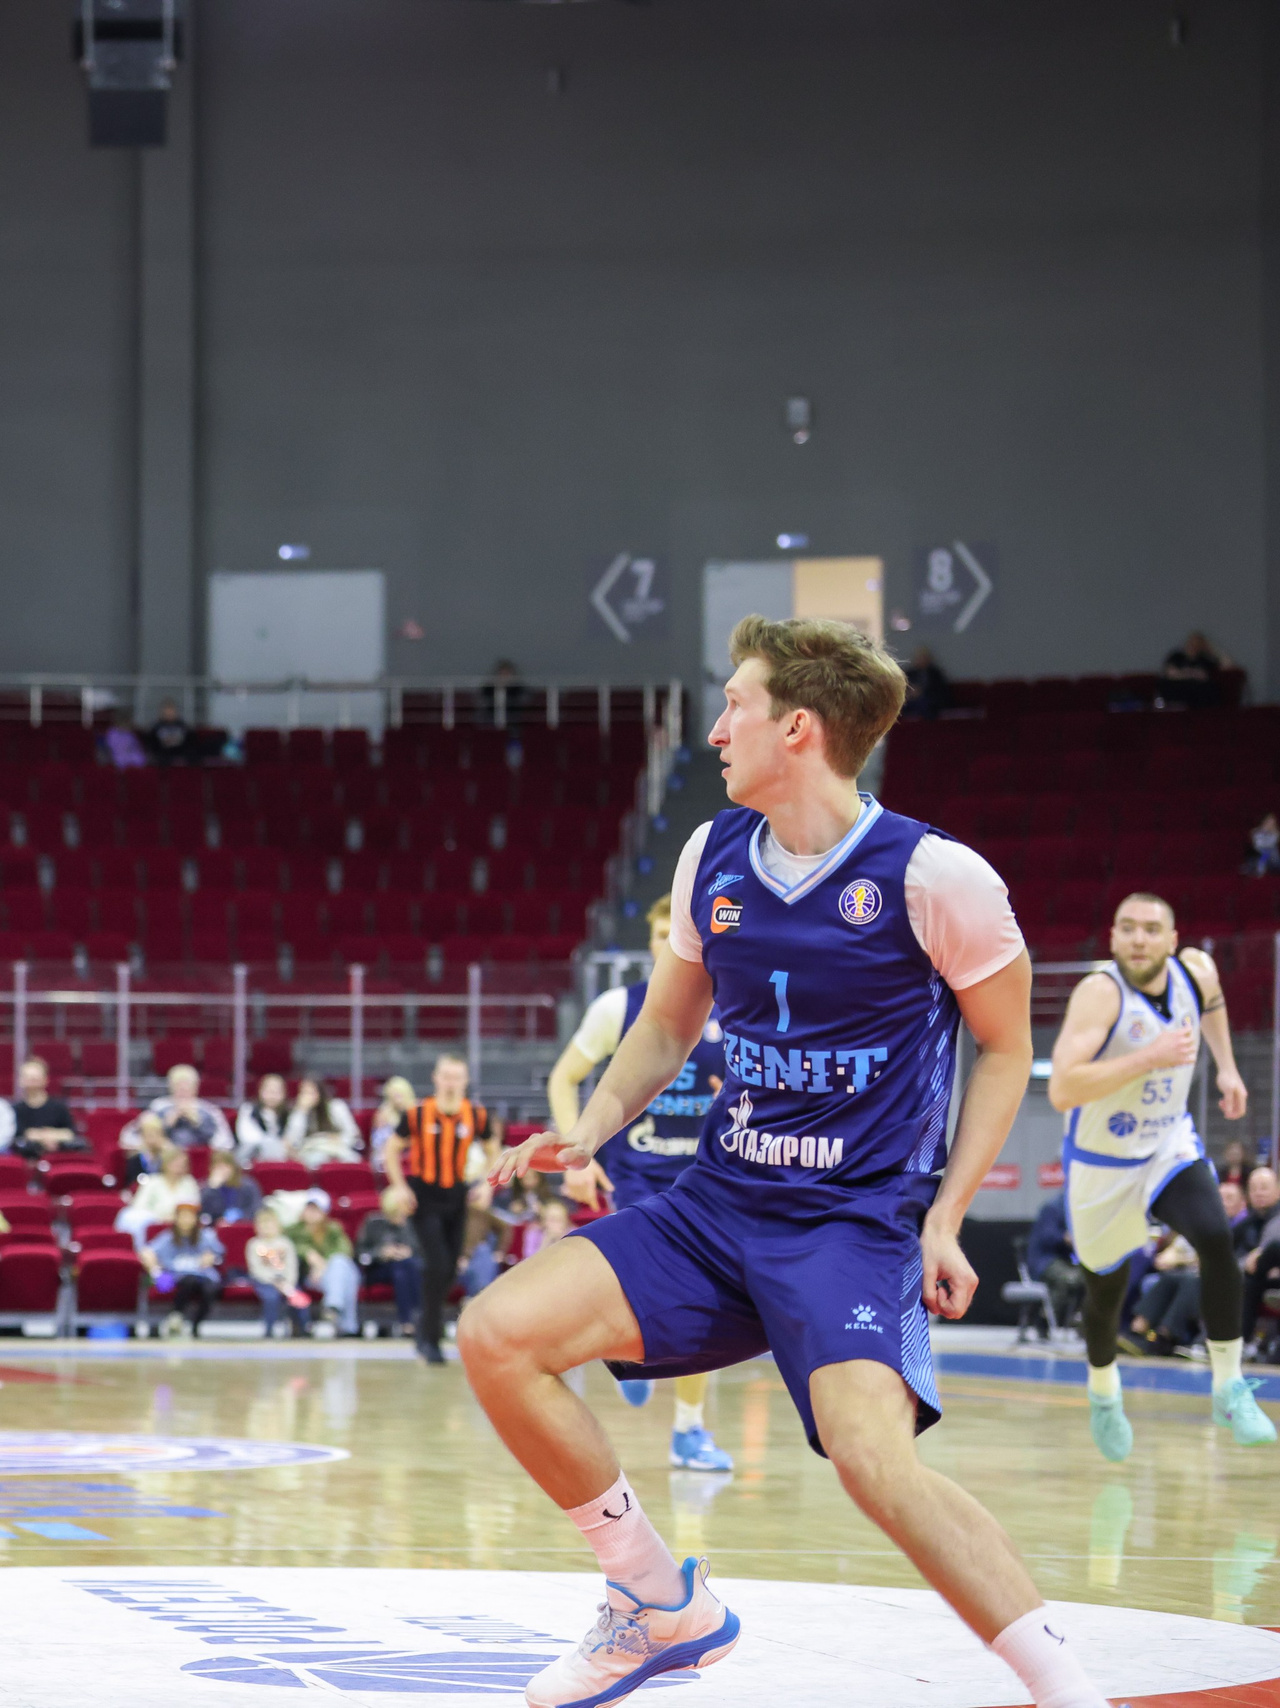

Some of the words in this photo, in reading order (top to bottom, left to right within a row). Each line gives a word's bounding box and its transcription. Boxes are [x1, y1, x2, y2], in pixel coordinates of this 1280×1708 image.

[630, 558, 656, 599] 7
[927, 548, 953, 593] 8
[768, 970, 790, 1033] 1
[724, 1033, 888, 1094] ZENIT
[1142, 1077, 1174, 1106] 53
[738, 1129, 844, 1169] ГАЗПРОМ
[844, 1322, 884, 1334] KELME
[61, 1579, 384, 1645] РОССЕТИ
